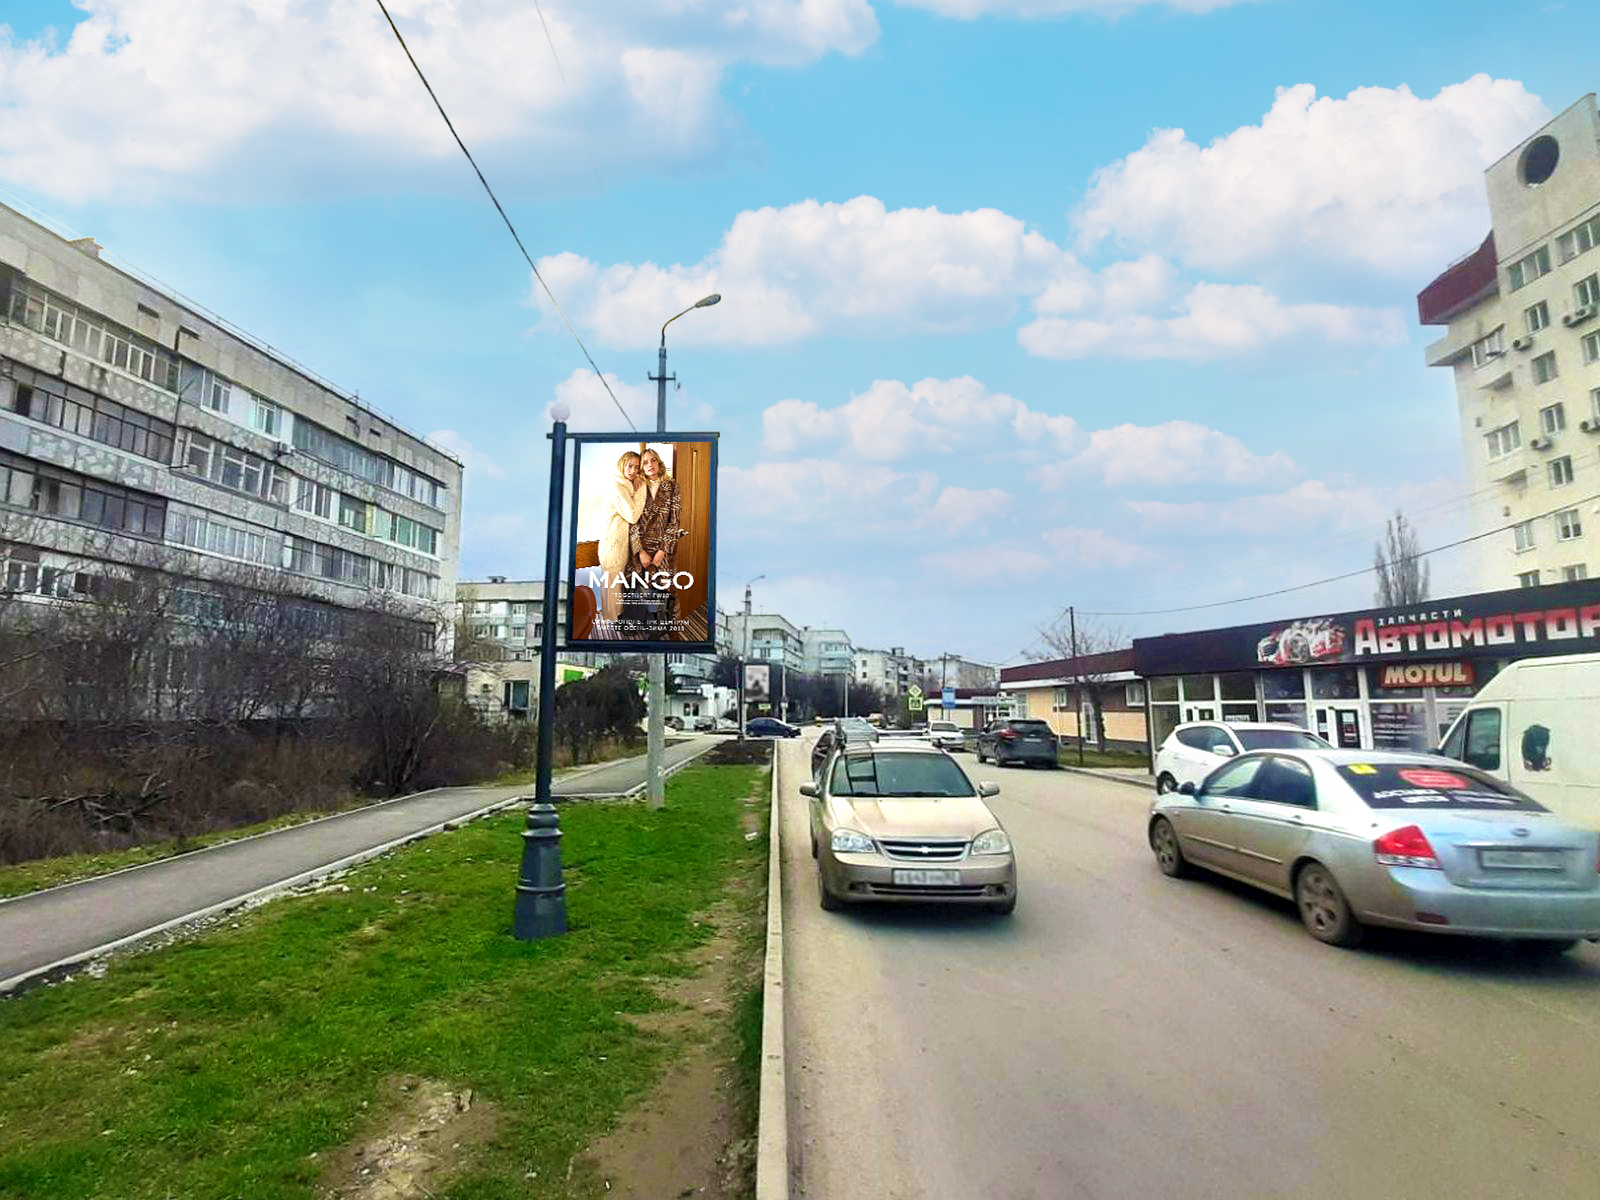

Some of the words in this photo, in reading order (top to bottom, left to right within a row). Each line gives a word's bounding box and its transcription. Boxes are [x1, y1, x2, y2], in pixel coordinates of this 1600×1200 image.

[589, 571, 694, 590] MANGO
[1378, 608, 1463, 627] ЗАПЧАСТИ
[1384, 662, 1467, 685] MOTUL
